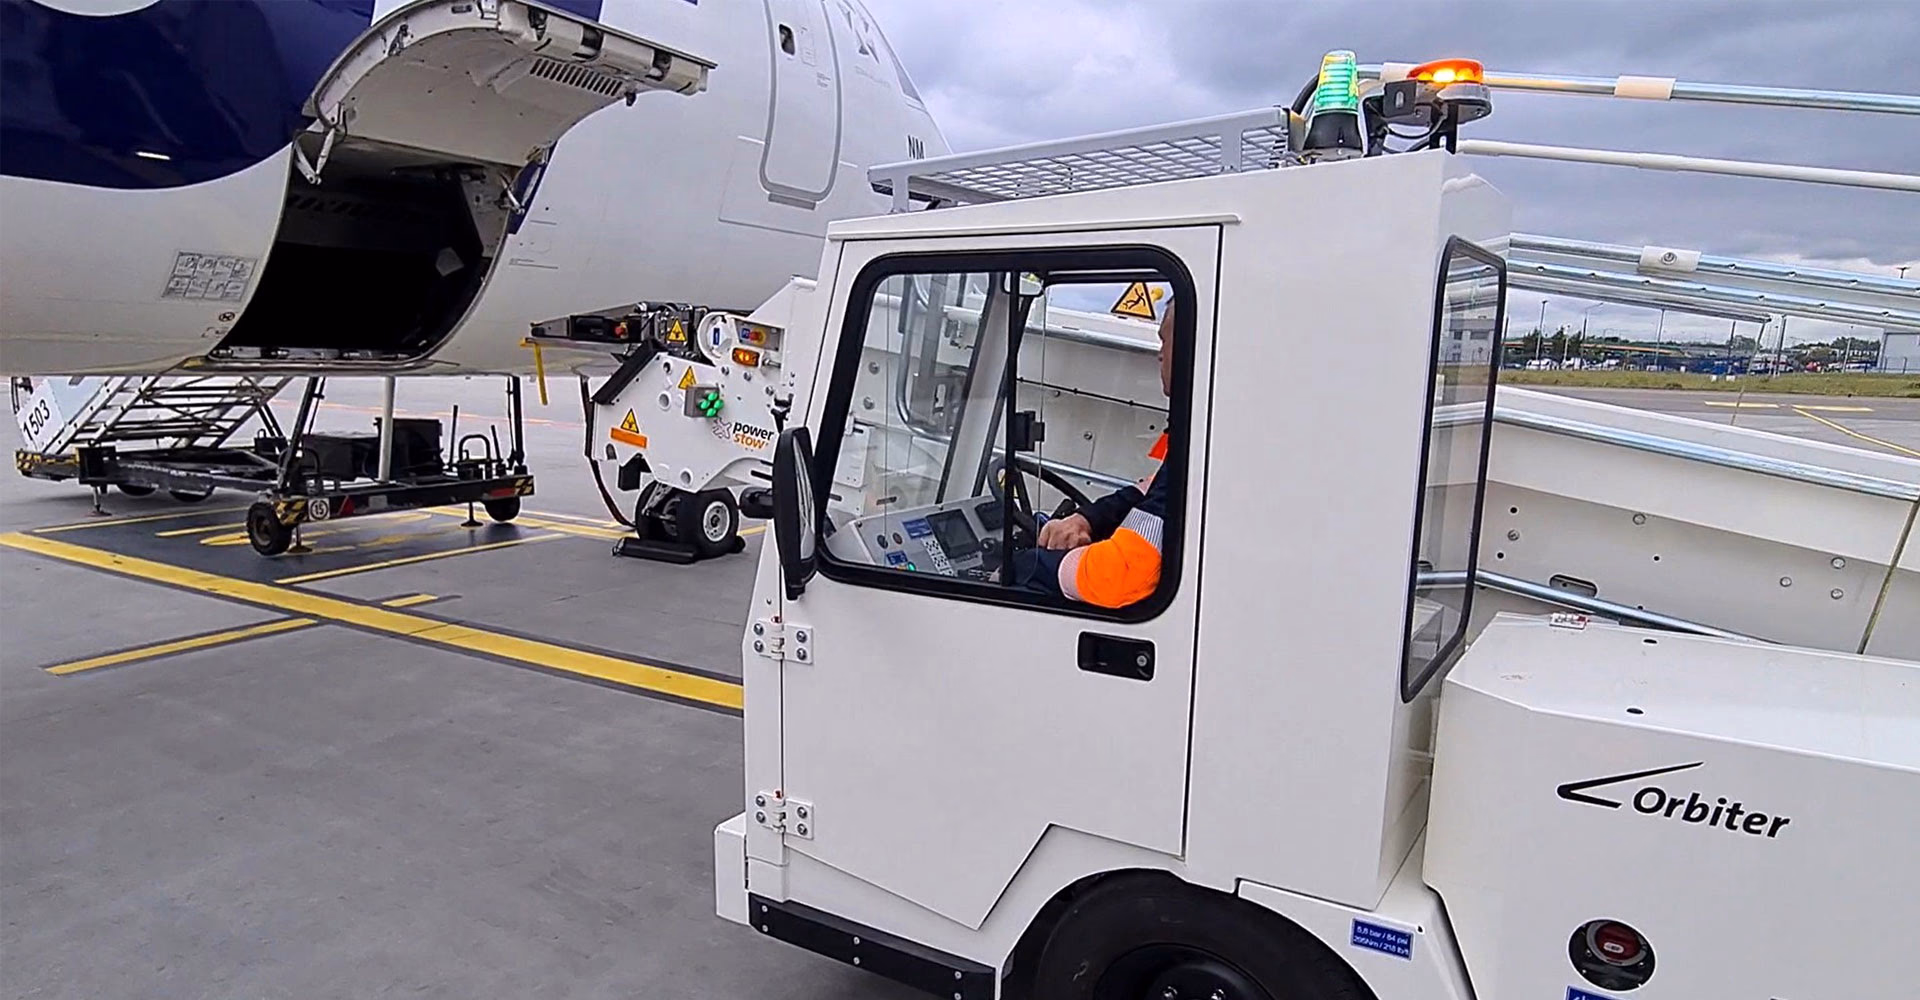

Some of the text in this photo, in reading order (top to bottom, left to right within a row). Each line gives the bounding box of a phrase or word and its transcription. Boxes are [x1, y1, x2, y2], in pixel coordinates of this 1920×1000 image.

[907, 134, 924, 160] NM
[23, 399, 50, 441] 1503
[733, 422, 774, 441] power
[734, 434, 766, 449] stow
[315, 504, 325, 515] 15
[1633, 786, 1791, 838] Orbiter
[1369, 929, 1382, 938] bar
